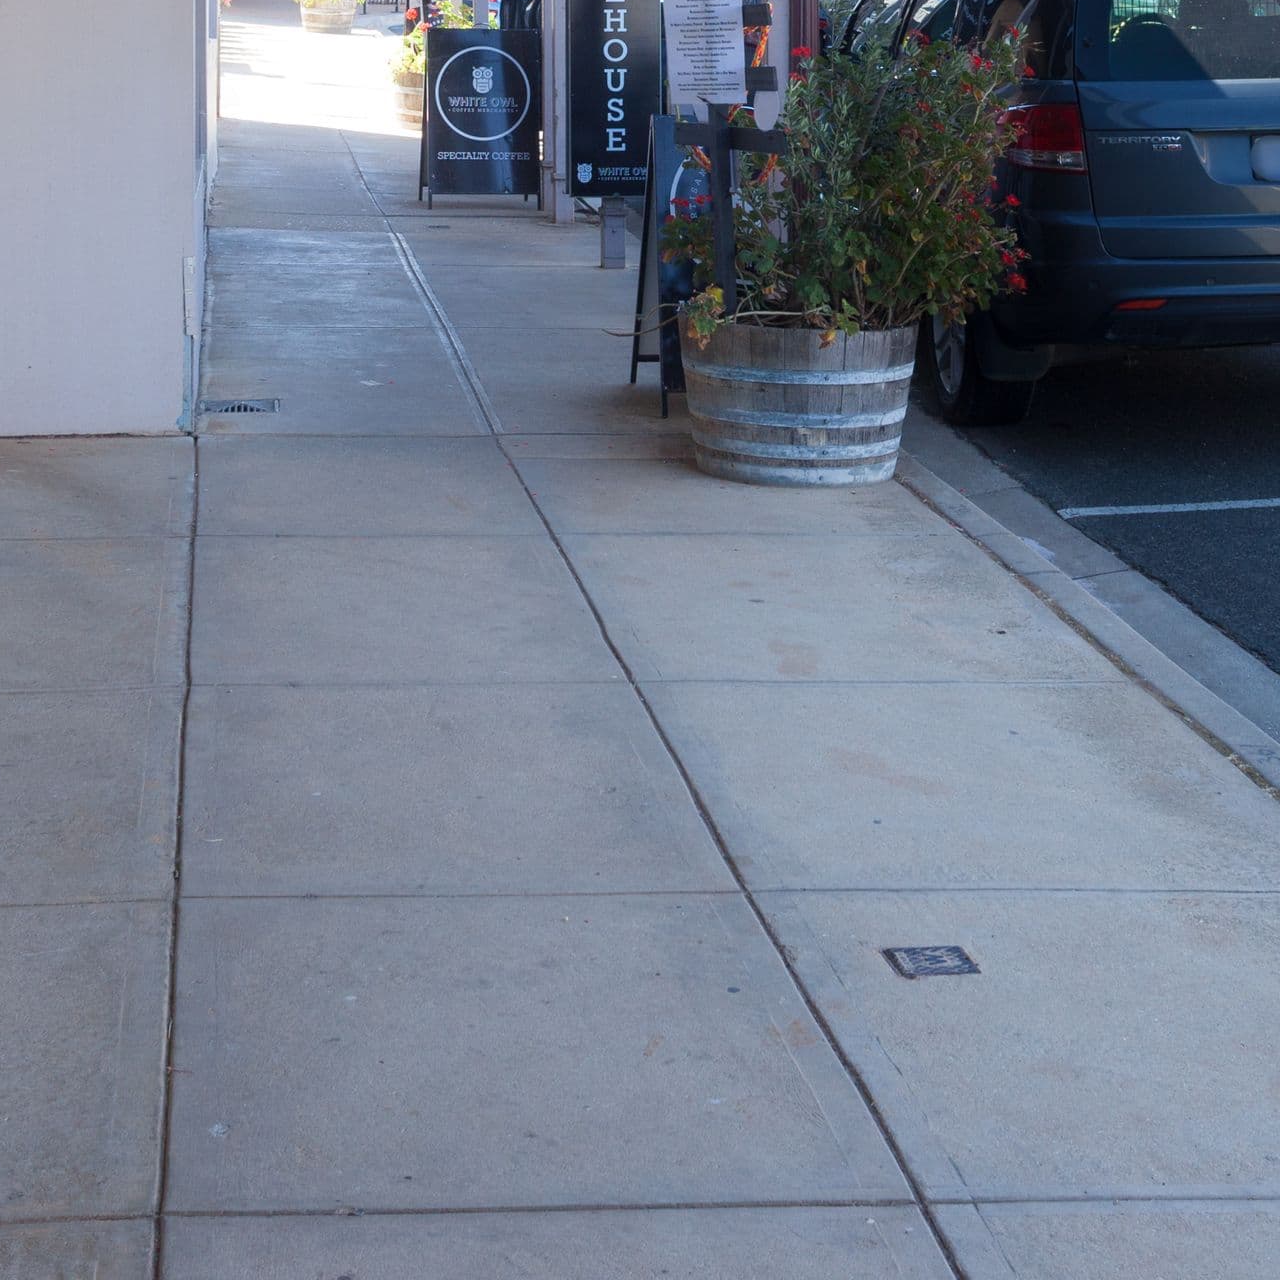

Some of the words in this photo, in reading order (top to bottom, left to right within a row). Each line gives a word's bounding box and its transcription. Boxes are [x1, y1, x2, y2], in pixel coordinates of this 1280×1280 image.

[448, 95, 488, 107] WHITE
[490, 96, 518, 108] OWL
[1098, 135, 1181, 144] TERRITORY
[437, 151, 490, 161] SPECIALTY
[491, 151, 530, 161] COFFEE
[598, 167, 630, 176] WHITE
[632, 167, 647, 176] OW
[689, 168, 706, 219] RTISAN
